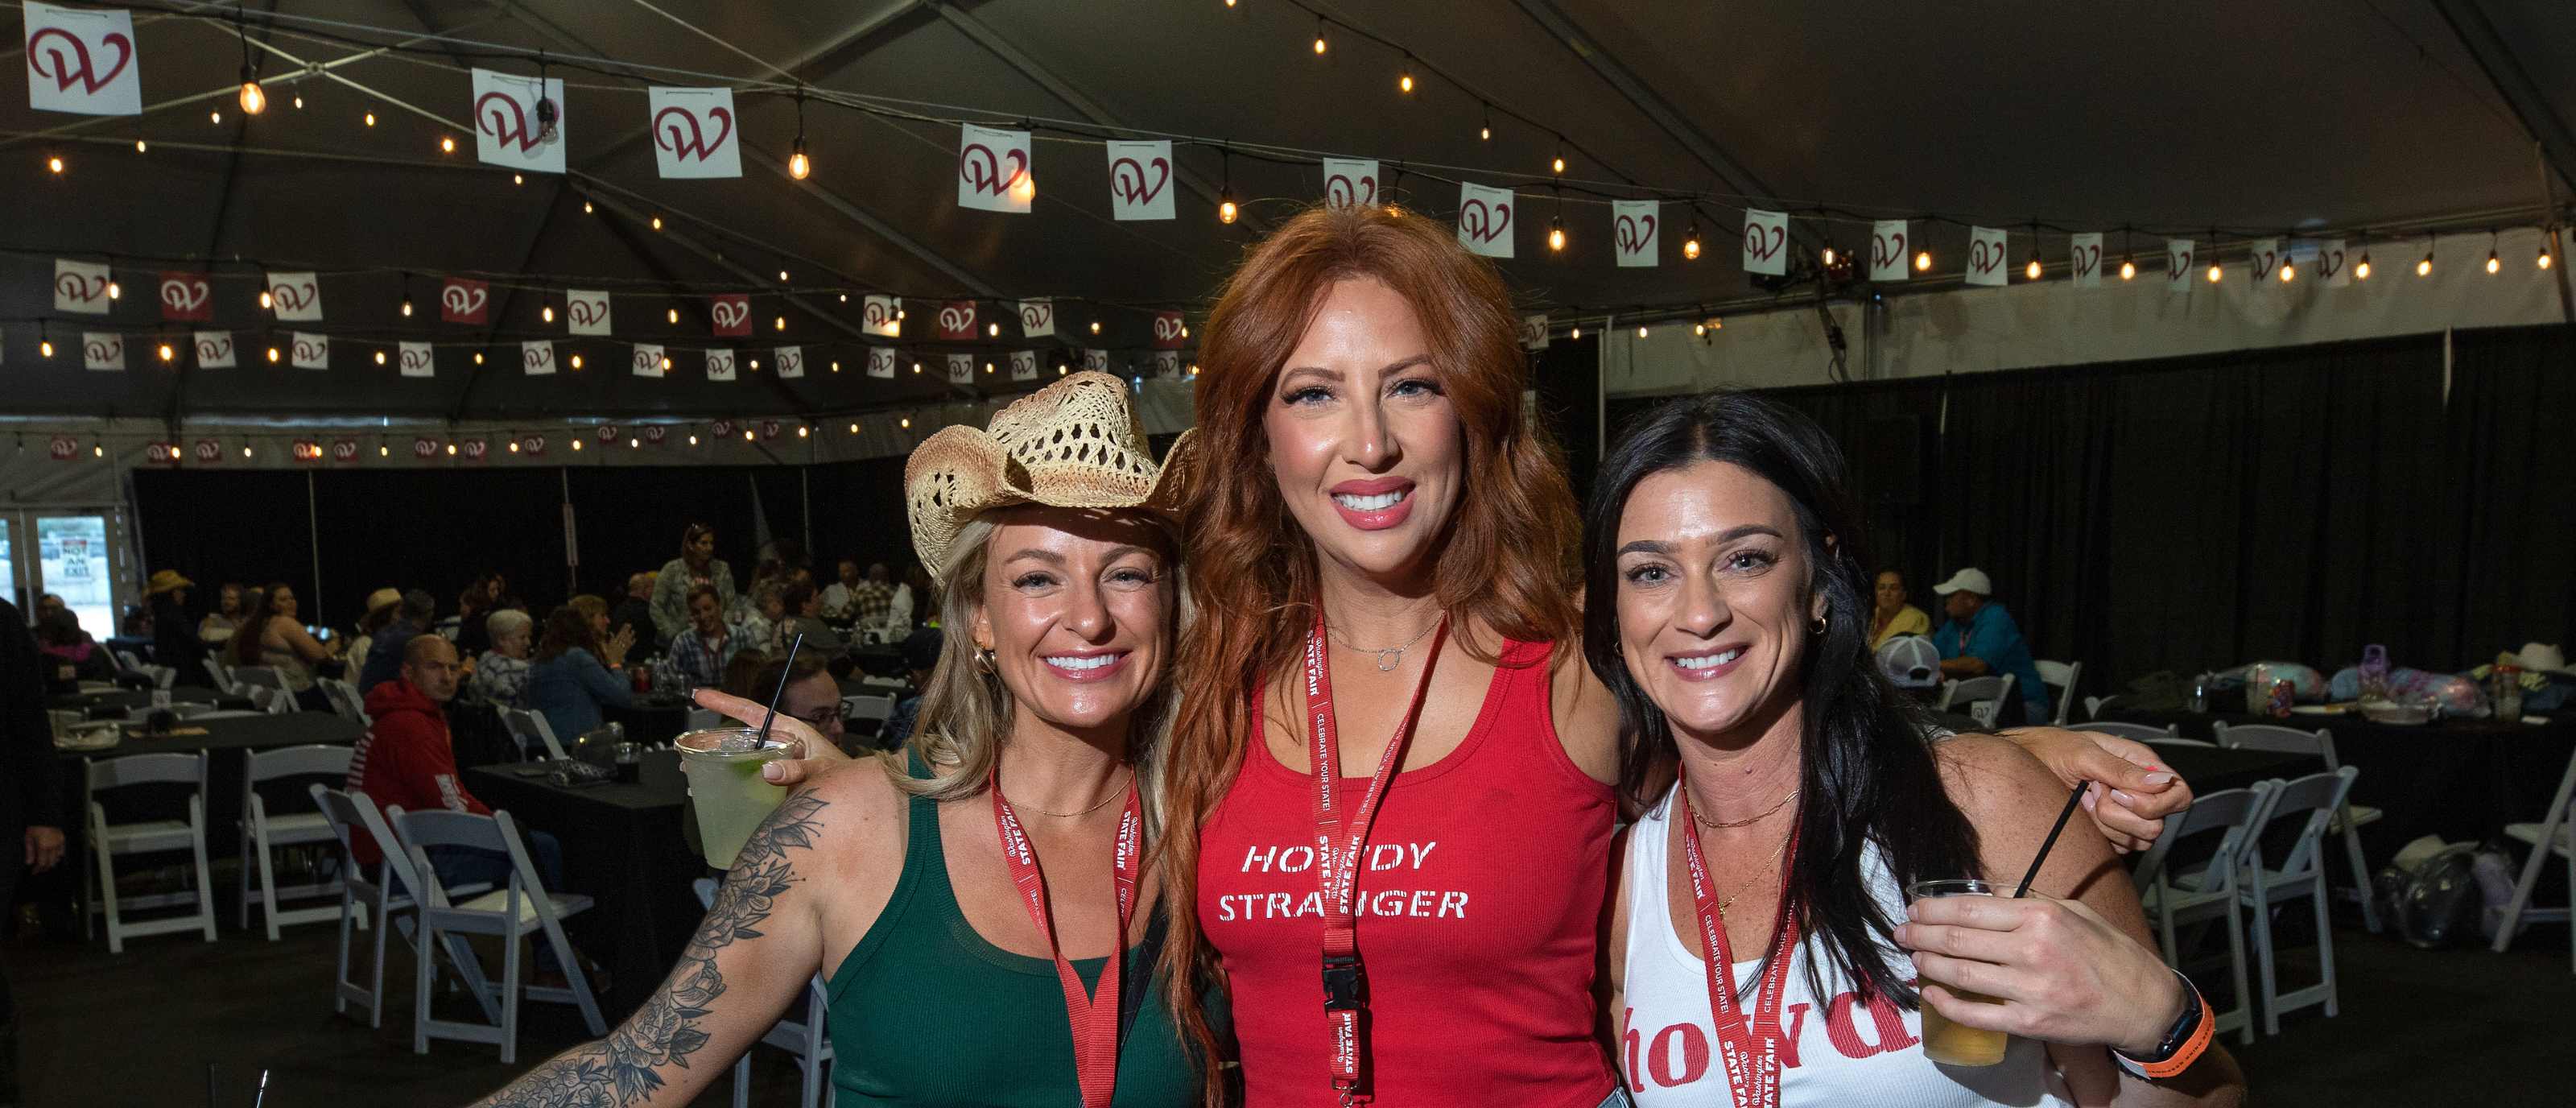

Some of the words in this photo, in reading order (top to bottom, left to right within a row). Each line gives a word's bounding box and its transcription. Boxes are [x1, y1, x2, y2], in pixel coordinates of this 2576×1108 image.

[1315, 638, 1323, 679] Washington
[1308, 668, 1318, 696] FAIR
[1317, 713, 1327, 759] CELEBRATE
[1320, 761, 1329, 783] YOUR
[1322, 784, 1331, 811] STATE!
[1001, 815, 1016, 857] Washington
[1119, 811, 1131, 841] STATE
[1128, 817, 1138, 856] Washington
[1013, 829, 1030, 866] STATE
[1117, 842, 1126, 869] FAIR
[1241, 841, 1436, 873] HODY
[1319, 835, 1331, 879] STATE
[1345, 835, 1360, 867] FAIR
[1331, 851, 1347, 899] Washington
[1340, 870, 1352, 914] STATE
[1692, 871, 1704, 899] FAIR
[1705, 915, 1721, 961] CELEBRATE
[1714, 961, 1724, 986] YOUR
[1764, 958, 1781, 1013] CELEBRATE
[1717, 985, 1729, 1014] STATE!
[1343, 1013, 1352, 1039] FAIR
[1337, 1027, 1345, 1062] Washington
[1345, 1039, 1353, 1074] STATE
[1765, 1038, 1775, 1072] FAIR
[1724, 1040, 1744, 1085] STATE
[1752, 1055, 1765, 1106] Washington
[1764, 1075, 1775, 1108] TATE
